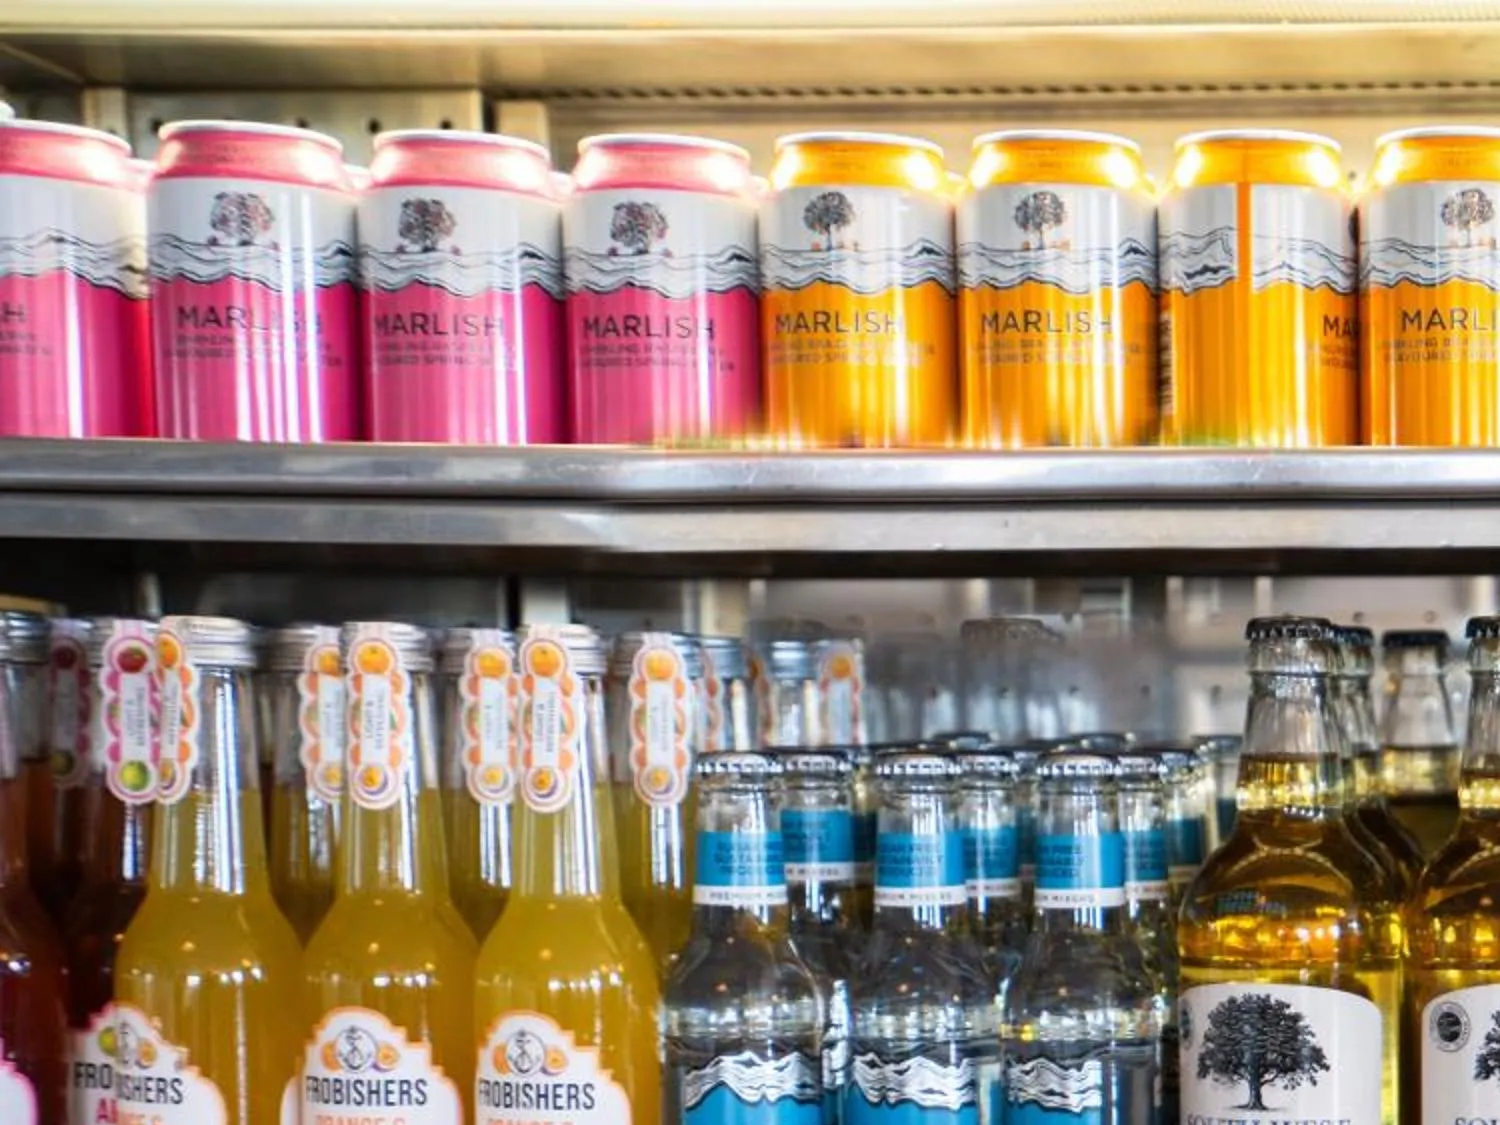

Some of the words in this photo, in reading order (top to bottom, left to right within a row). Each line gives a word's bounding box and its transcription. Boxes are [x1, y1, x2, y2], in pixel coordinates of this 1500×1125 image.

[374, 312, 504, 337] MARLISH
[583, 314, 714, 340] MARLISH
[775, 310, 905, 334] MARLISH
[980, 310, 1114, 334] MARLISH
[305, 1075, 429, 1107] FROBISHERS
[479, 1078, 596, 1111] FROBISHERS
